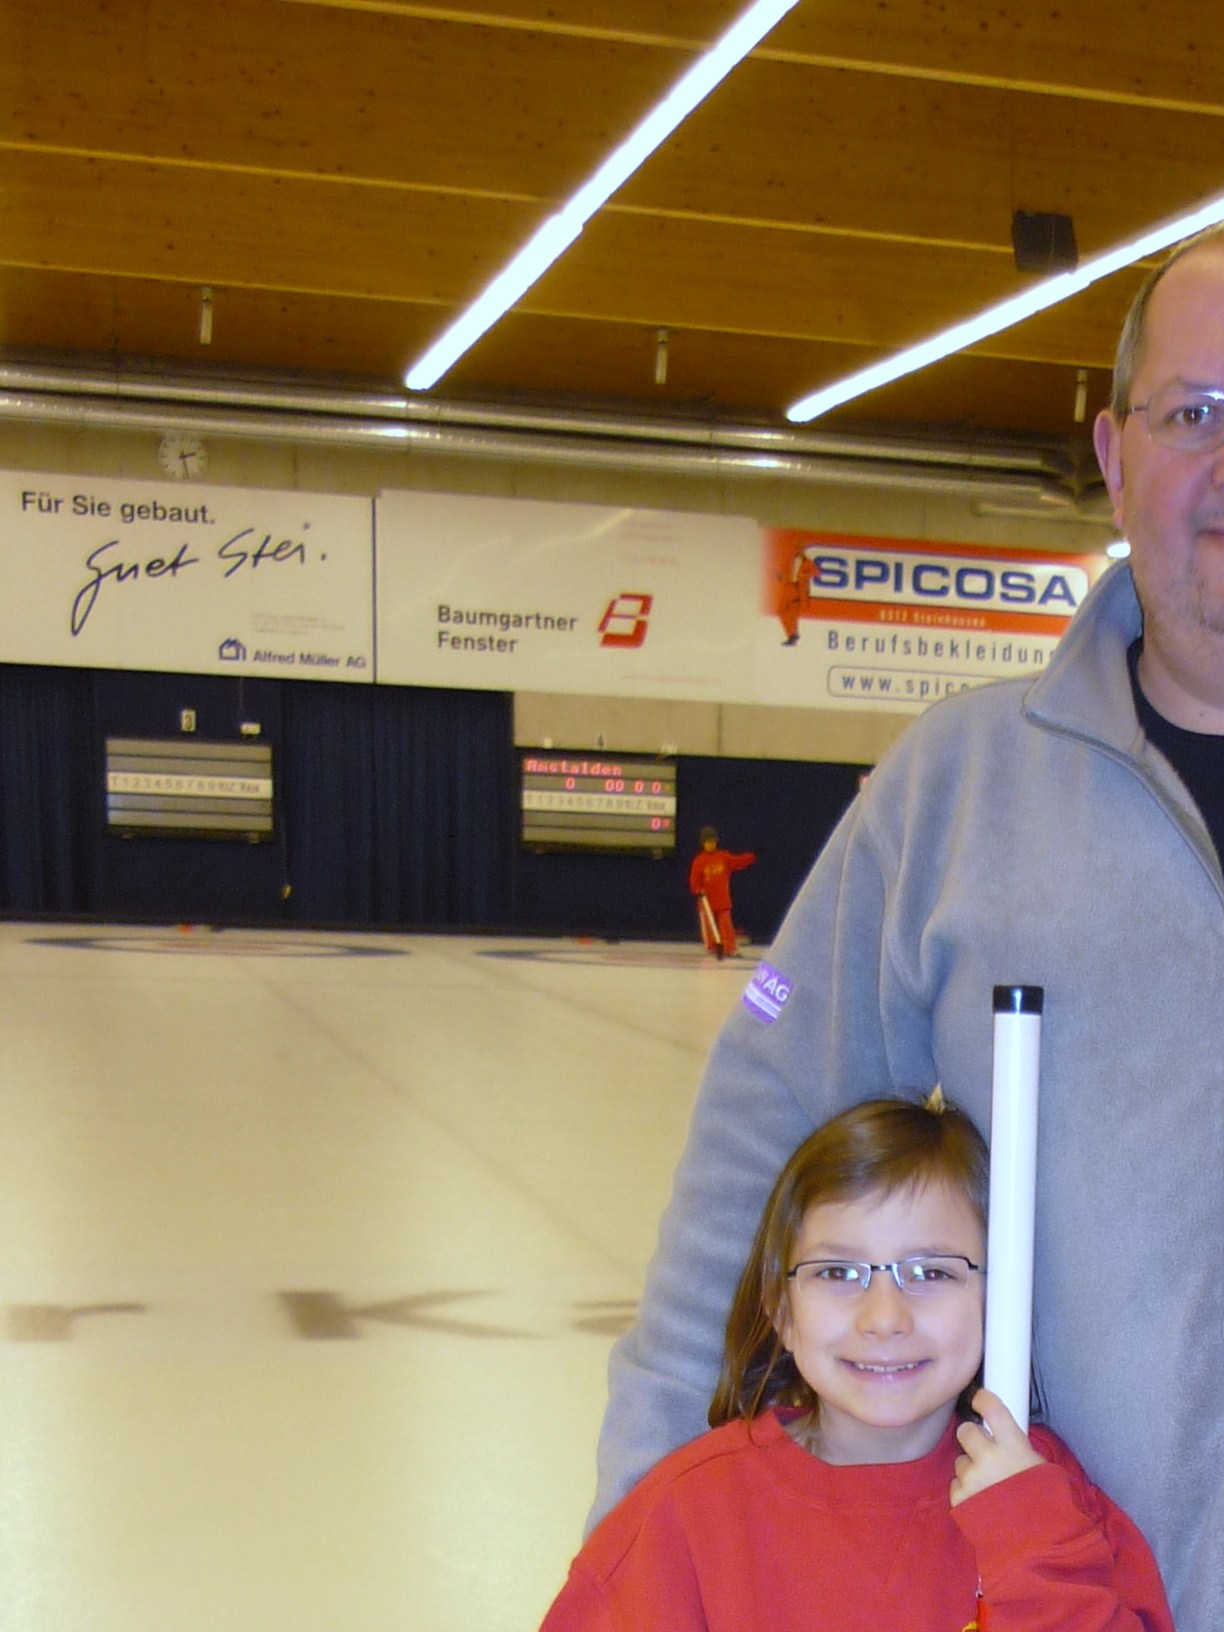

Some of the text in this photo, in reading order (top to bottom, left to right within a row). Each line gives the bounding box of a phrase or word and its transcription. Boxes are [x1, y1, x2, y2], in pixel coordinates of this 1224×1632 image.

[21, 491, 216, 525] Für Sie gebaut.
[812, 555, 1078, 608] SPICOSA
[437, 604, 579, 632] Baumgartner
[437, 631, 518, 654] Fenster
[253, 650, 367, 669] Alfred Müller AG
